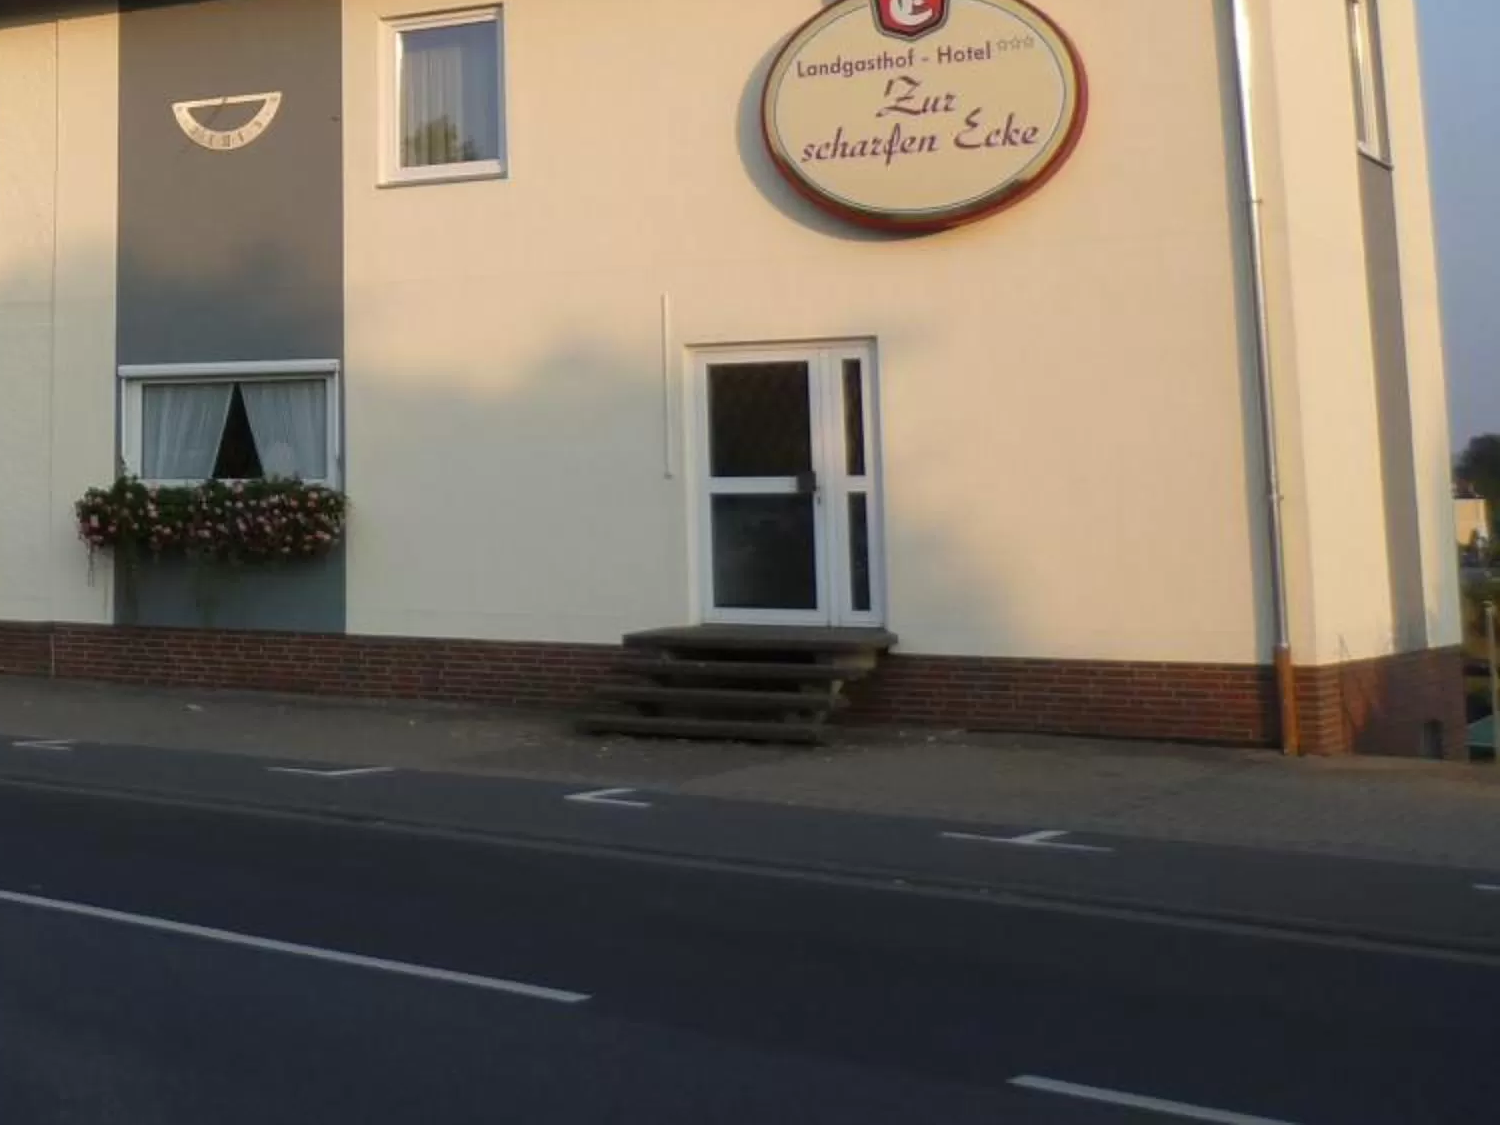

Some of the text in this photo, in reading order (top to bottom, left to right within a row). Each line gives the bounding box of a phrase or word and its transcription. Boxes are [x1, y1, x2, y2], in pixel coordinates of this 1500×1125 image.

[797, 48, 914, 78] Landgasthof
[937, 41, 991, 65] Hotel
[875, 75, 957, 118] Zur
[801, 107, 1040, 166] scharfen Ecke
